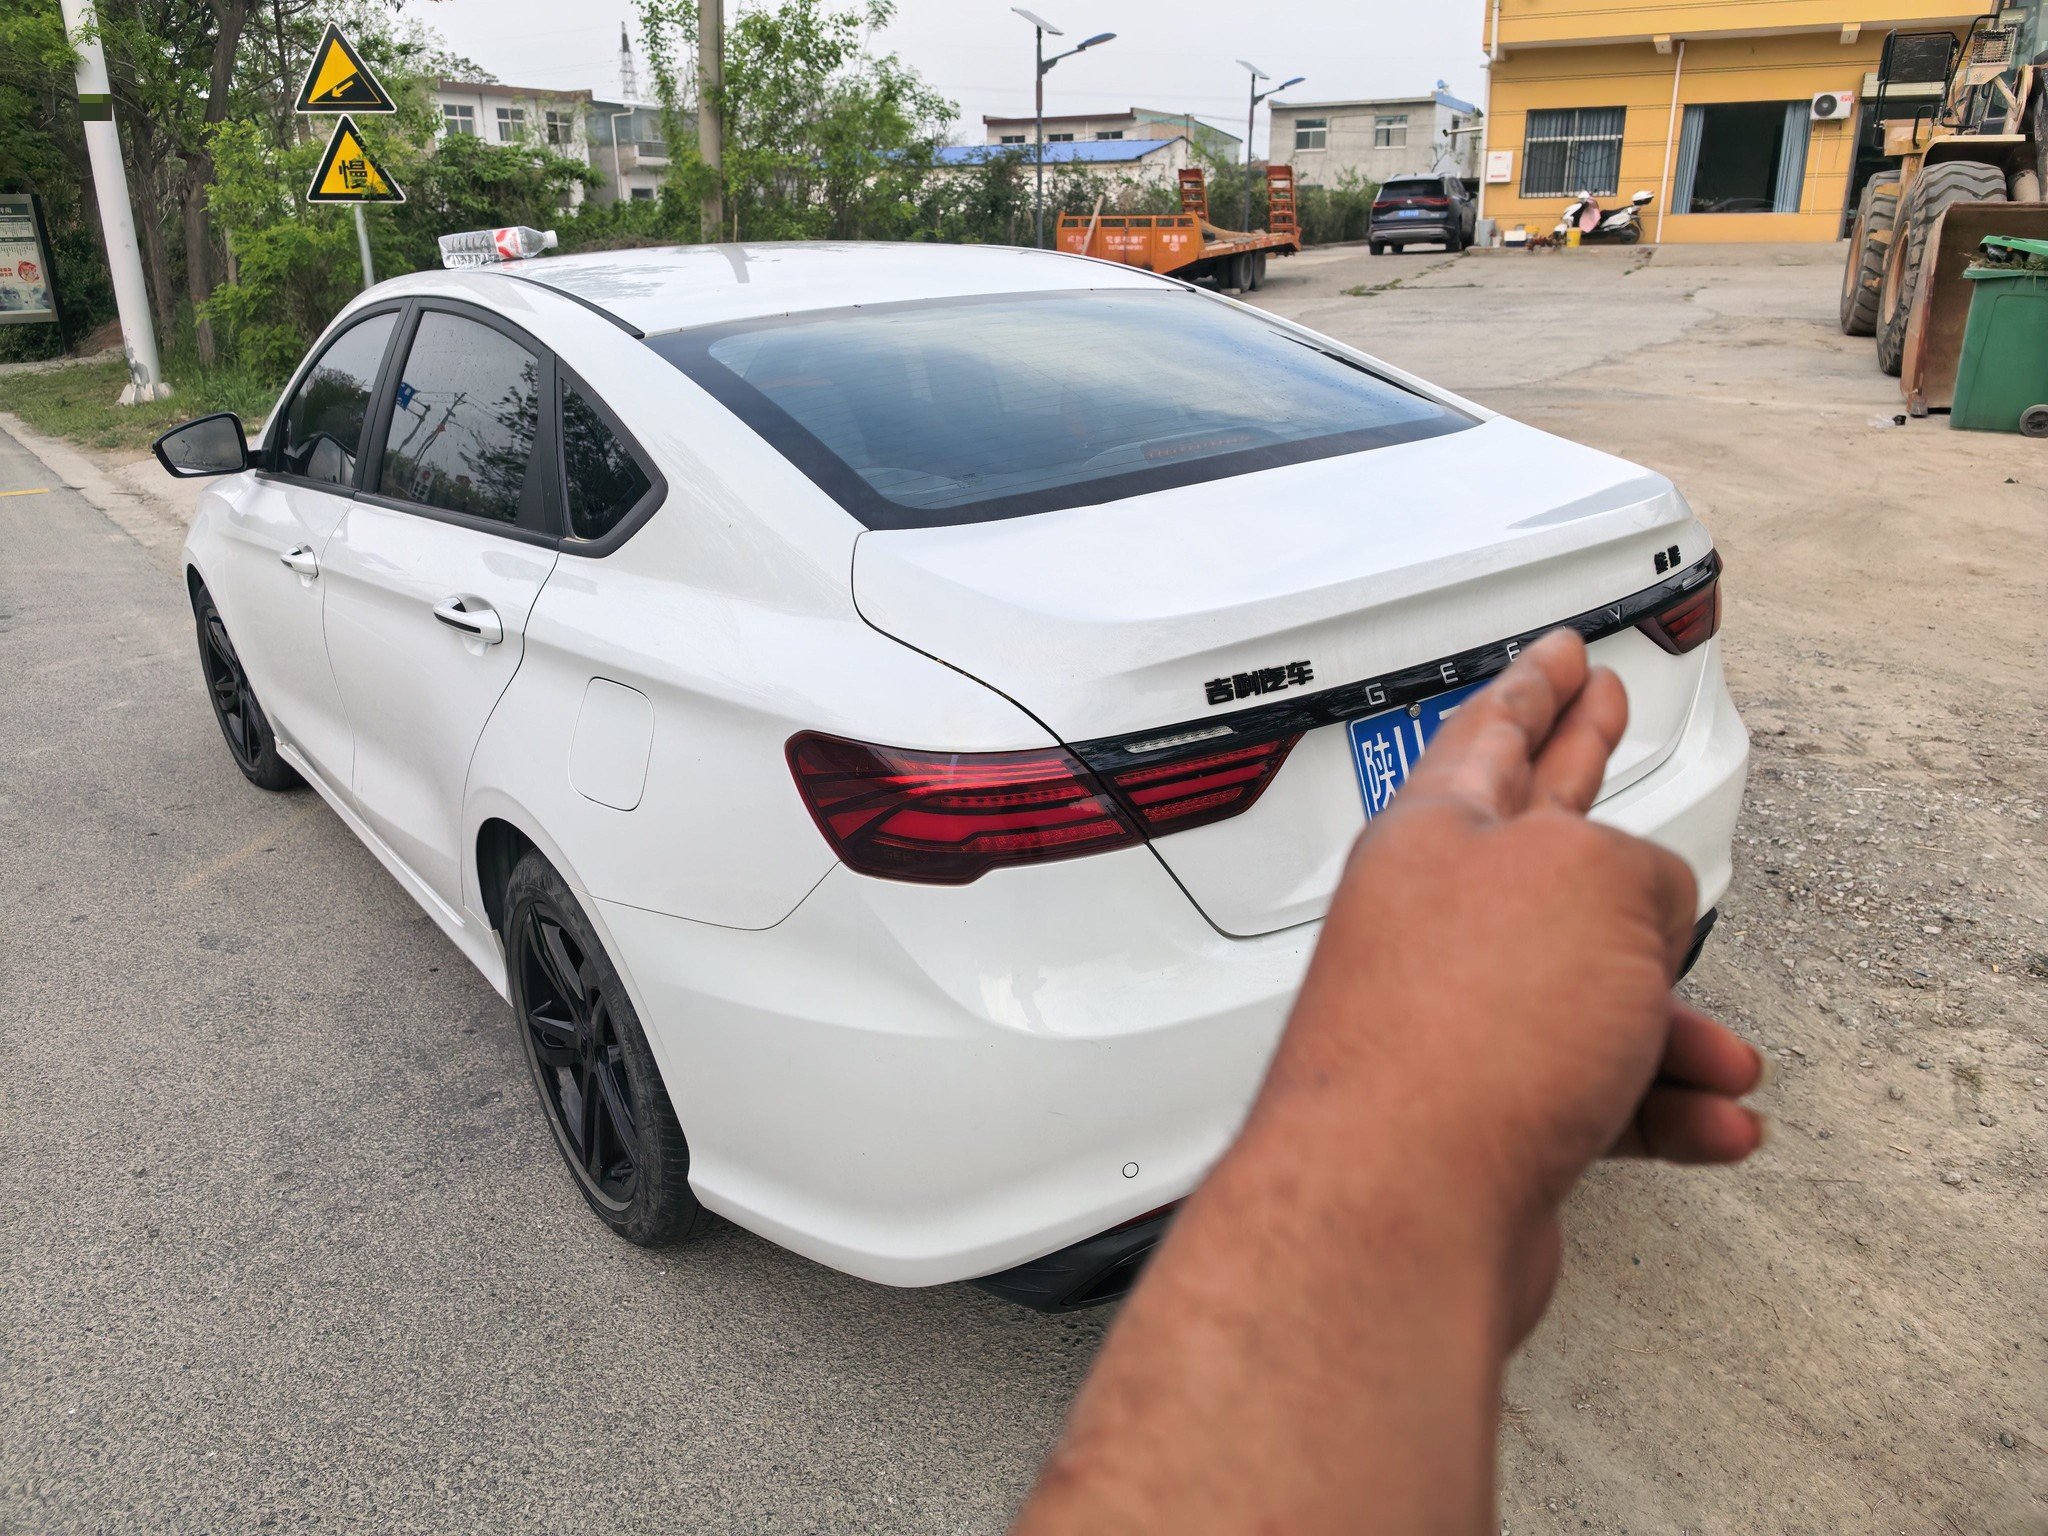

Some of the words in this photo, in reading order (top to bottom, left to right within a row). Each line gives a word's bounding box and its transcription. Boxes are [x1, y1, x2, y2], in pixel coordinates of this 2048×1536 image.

[339, 160, 368, 189] 慢
[1365, 605, 1622, 706] GEEY
[1204, 660, 1315, 705] 吉利汽车
